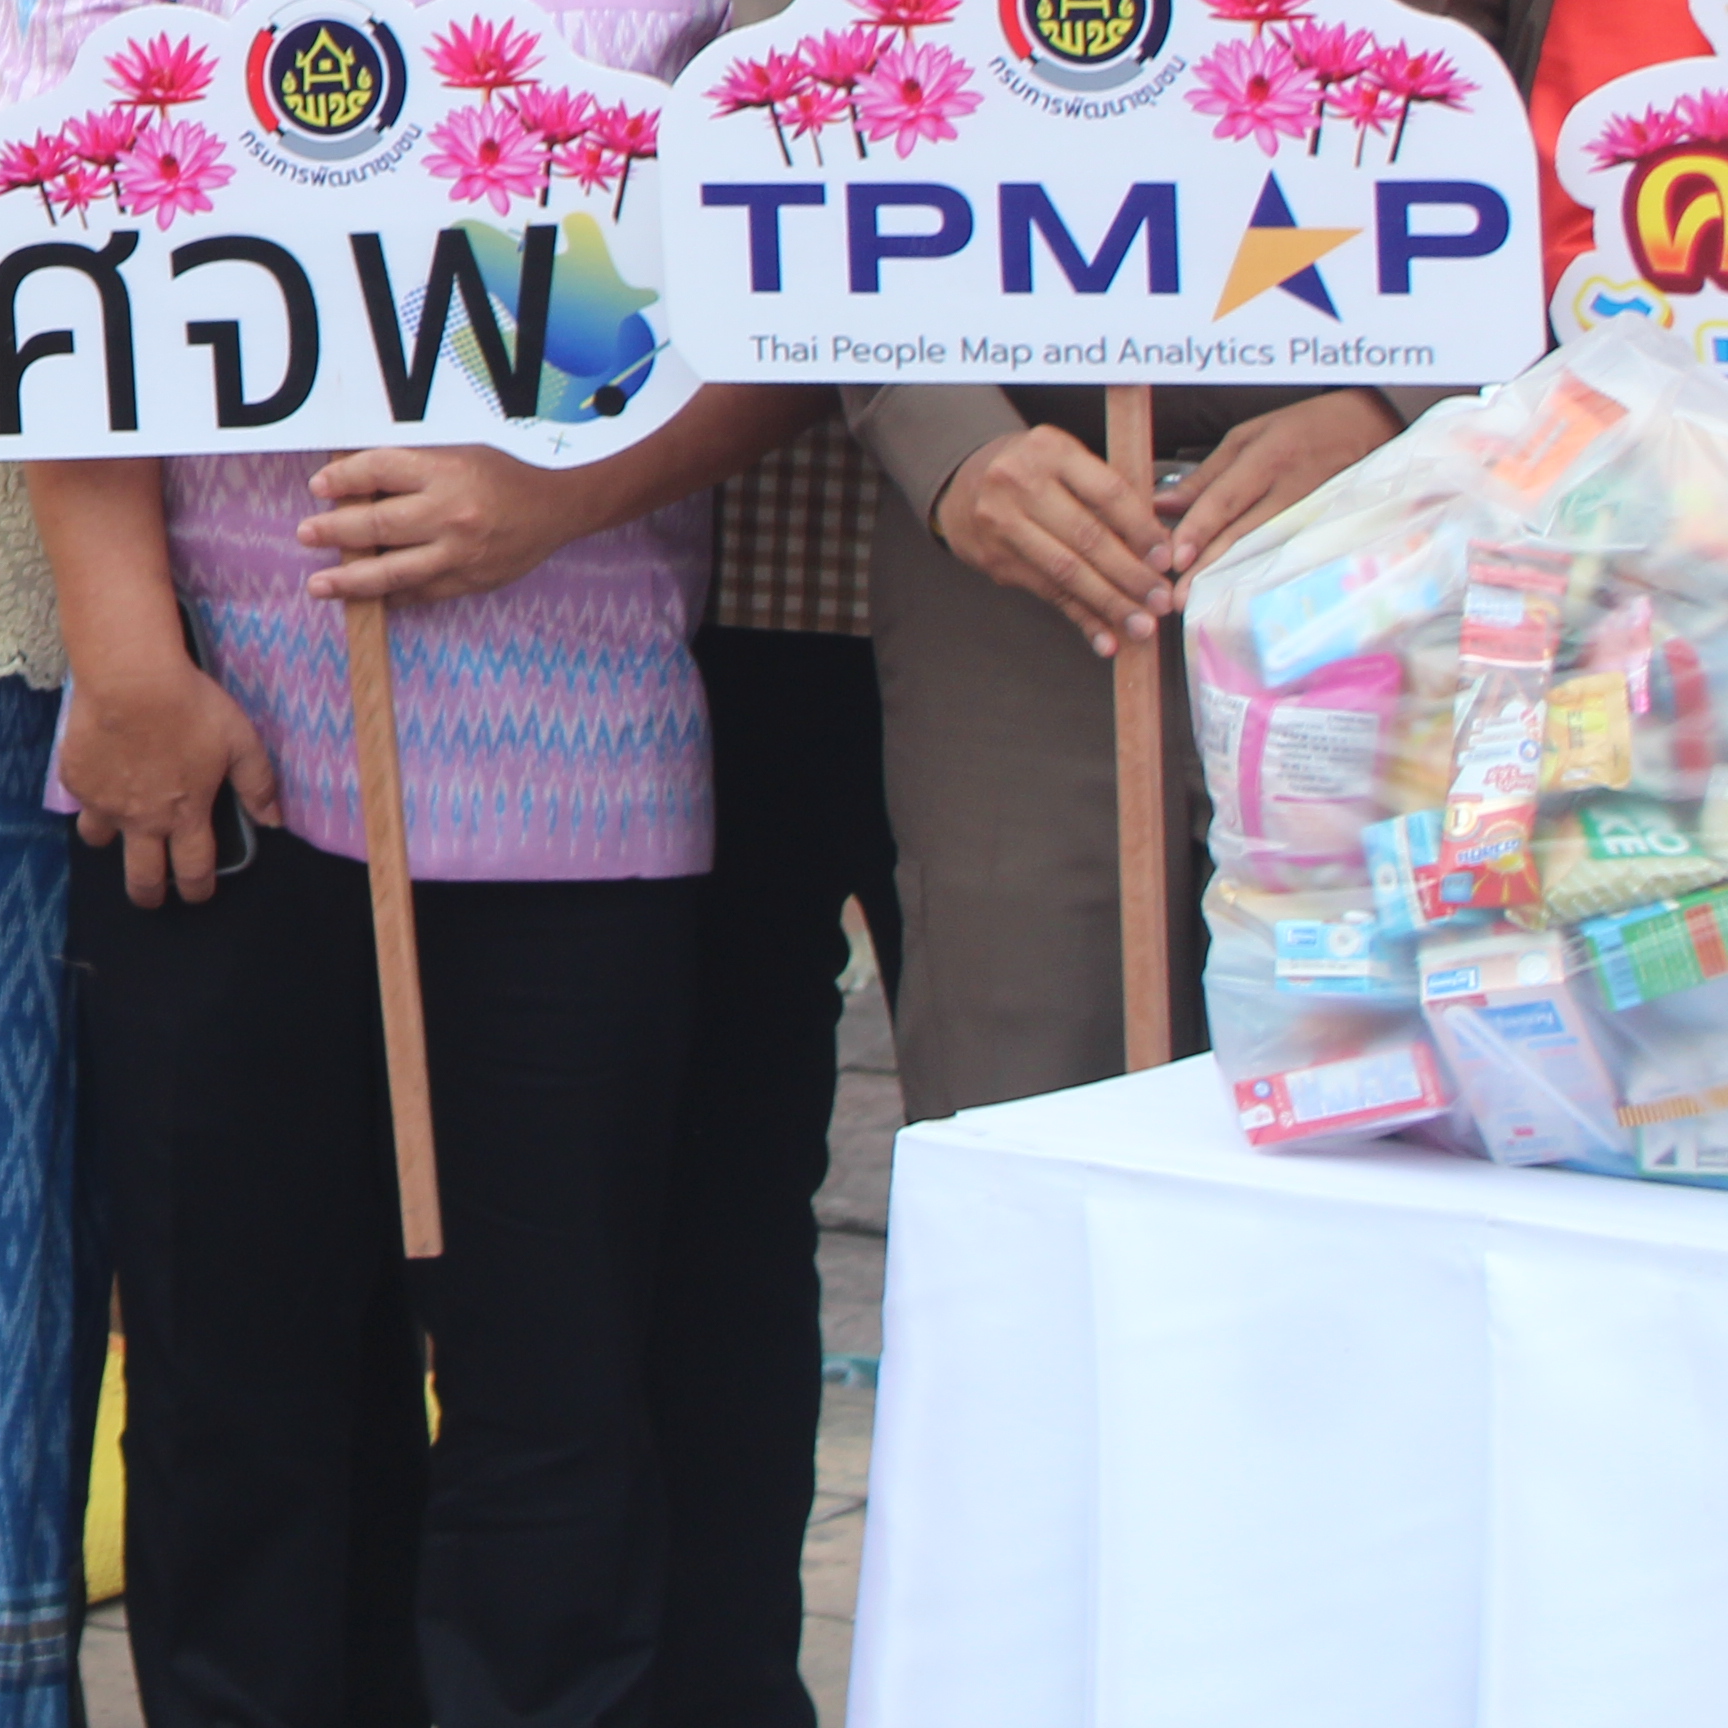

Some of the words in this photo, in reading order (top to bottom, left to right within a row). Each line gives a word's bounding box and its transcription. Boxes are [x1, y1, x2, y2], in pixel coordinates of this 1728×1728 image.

[987, 54, 1187, 119] กรมการพัฒนาชุมชน
[238, 123, 424, 188] กรมการพัฒนาชุมชน
[701, 169, 1512, 325] TPMAP
[750, 334, 818, 363] Thai
[832, 335, 947, 370] People
[960, 336, 1033, 371] Map
[1043, 336, 1107, 365] and
[1117, 336, 1275, 372] Analytics
[1289, 336, 1434, 366] Platform
